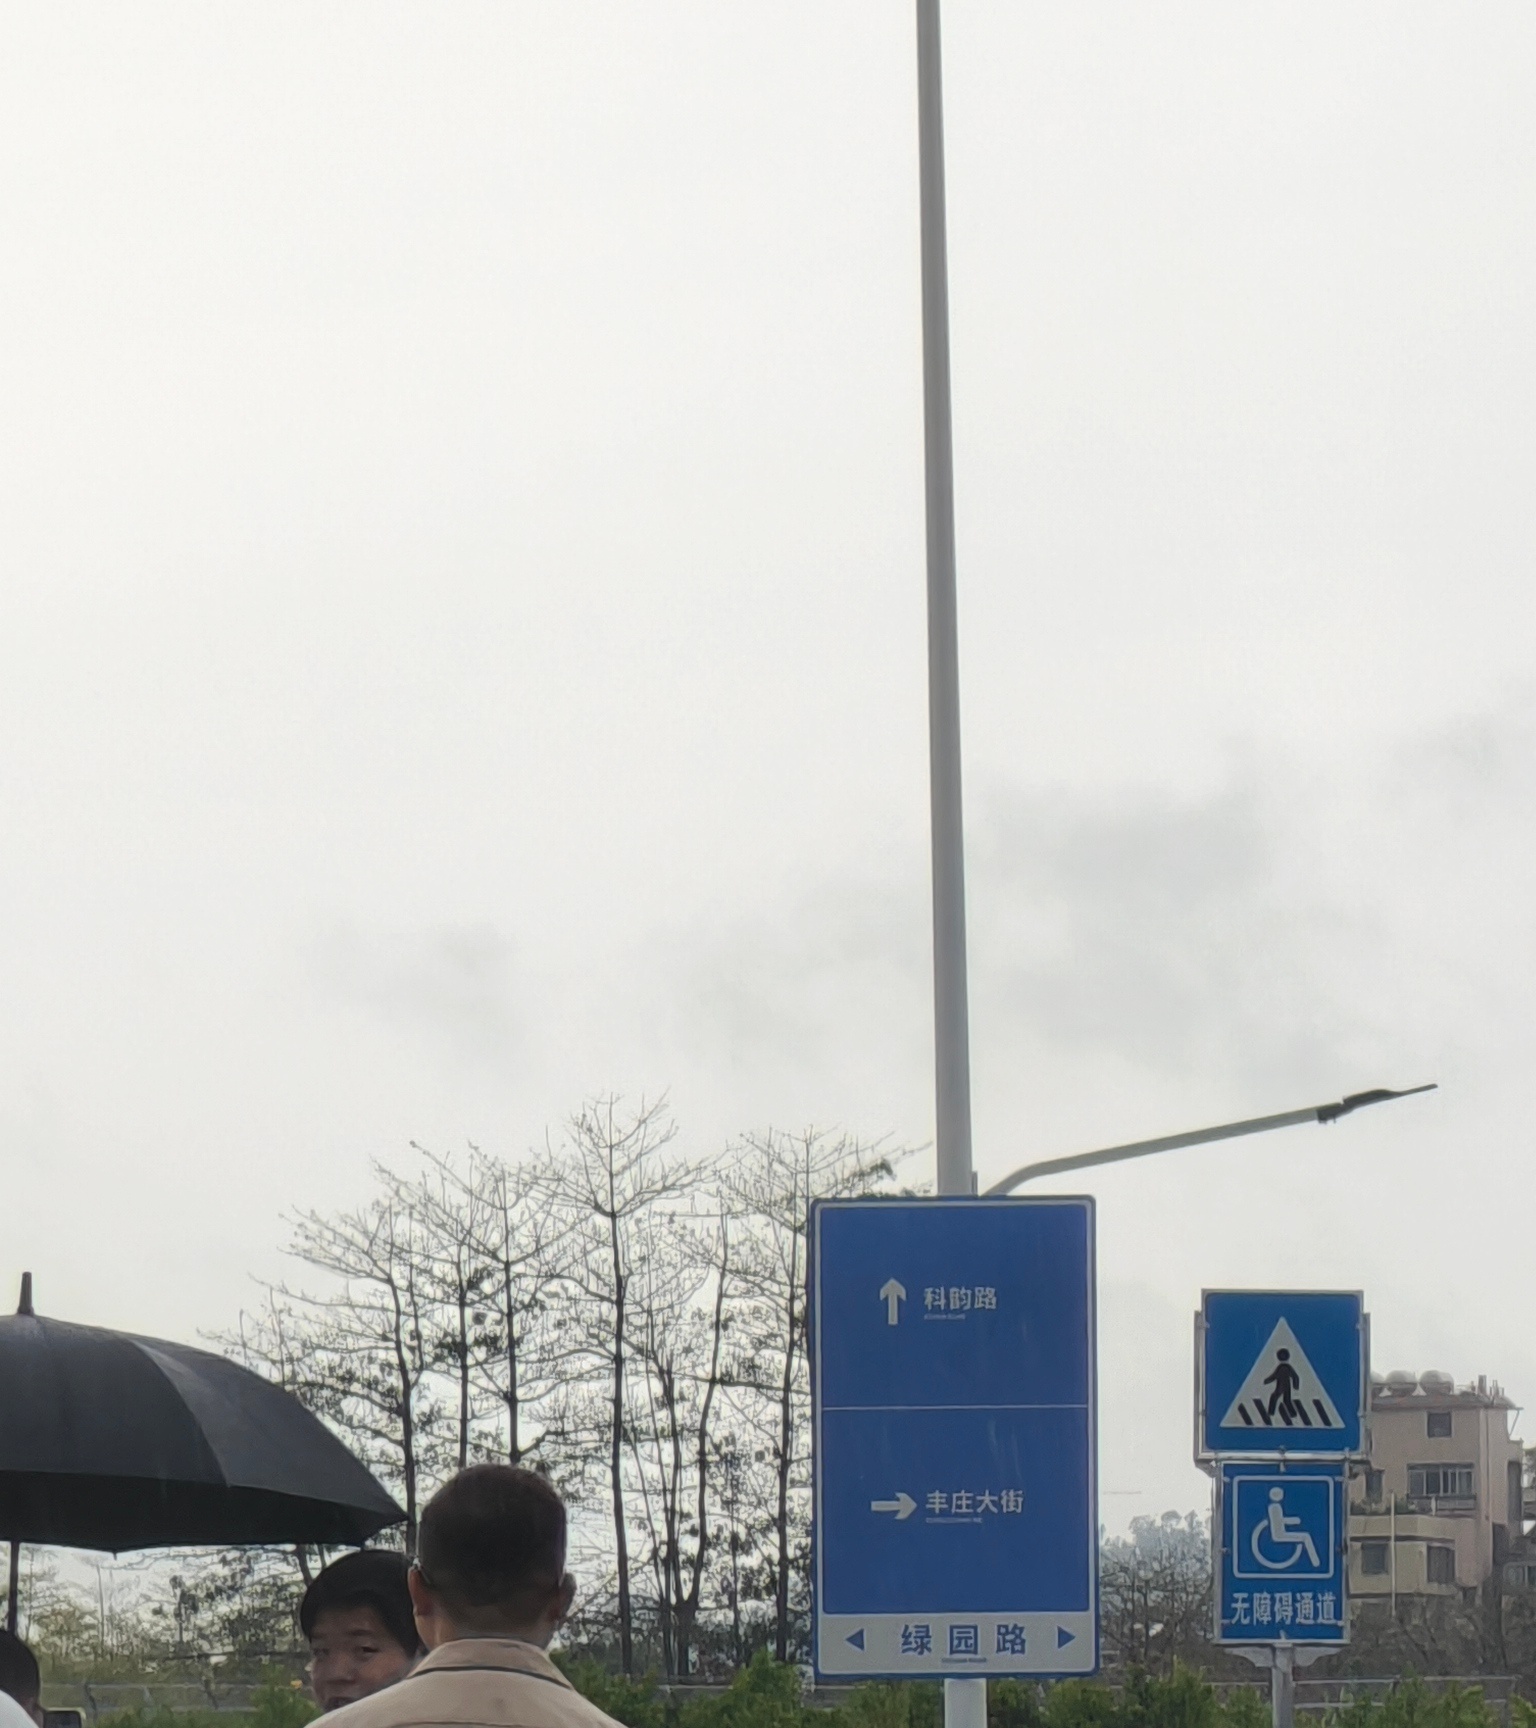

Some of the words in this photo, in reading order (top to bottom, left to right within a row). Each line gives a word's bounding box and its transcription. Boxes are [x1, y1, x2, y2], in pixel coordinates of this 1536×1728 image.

[924, 1286, 997, 1311] 科韵路
[925, 1489, 1024, 1514] 丰庄大街
[1231, 1591, 1337, 1626] 无障碍通道
[901, 1624, 1026, 1655] 绿园路
